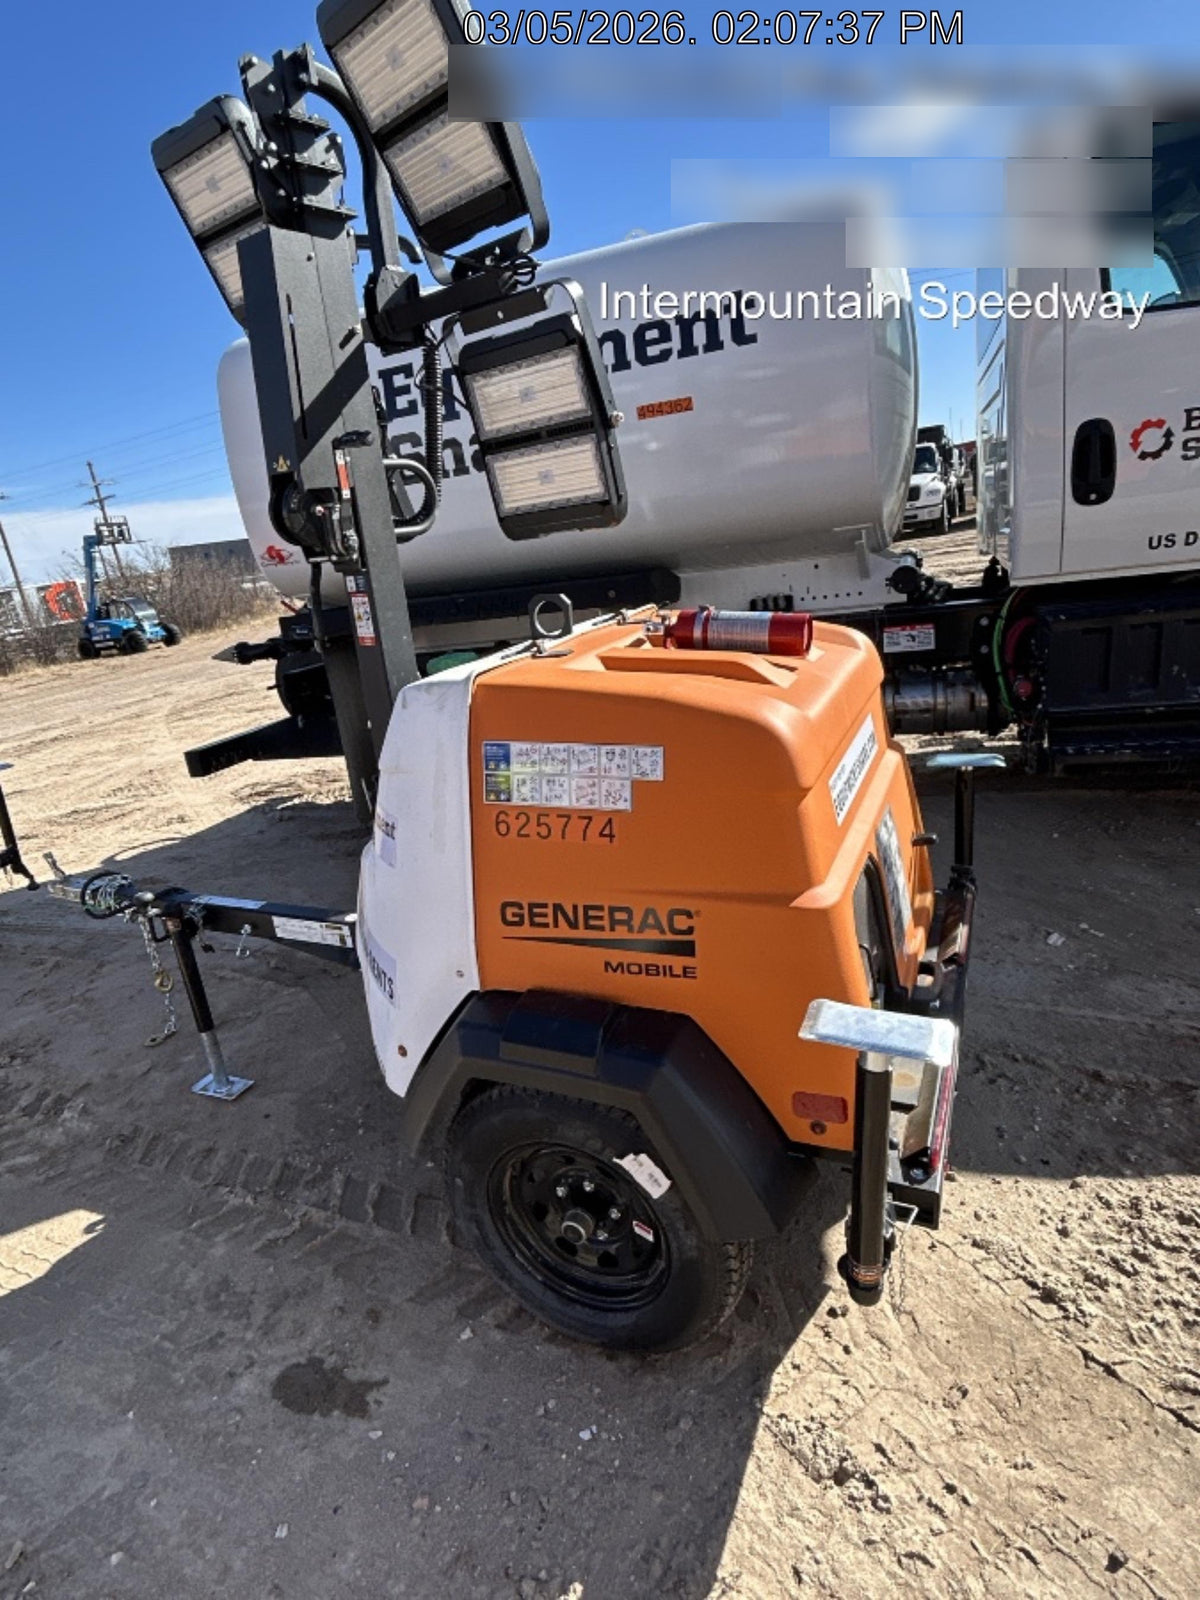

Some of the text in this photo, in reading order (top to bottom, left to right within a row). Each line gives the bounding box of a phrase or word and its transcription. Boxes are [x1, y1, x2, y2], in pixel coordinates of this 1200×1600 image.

[637, 396, 693, 420] 494362
[1148, 533, 1176, 549] US
[495, 810, 616, 844] 625774
[500, 900, 697, 936] GENERAC
[604, 960, 698, 979] MOBILE
